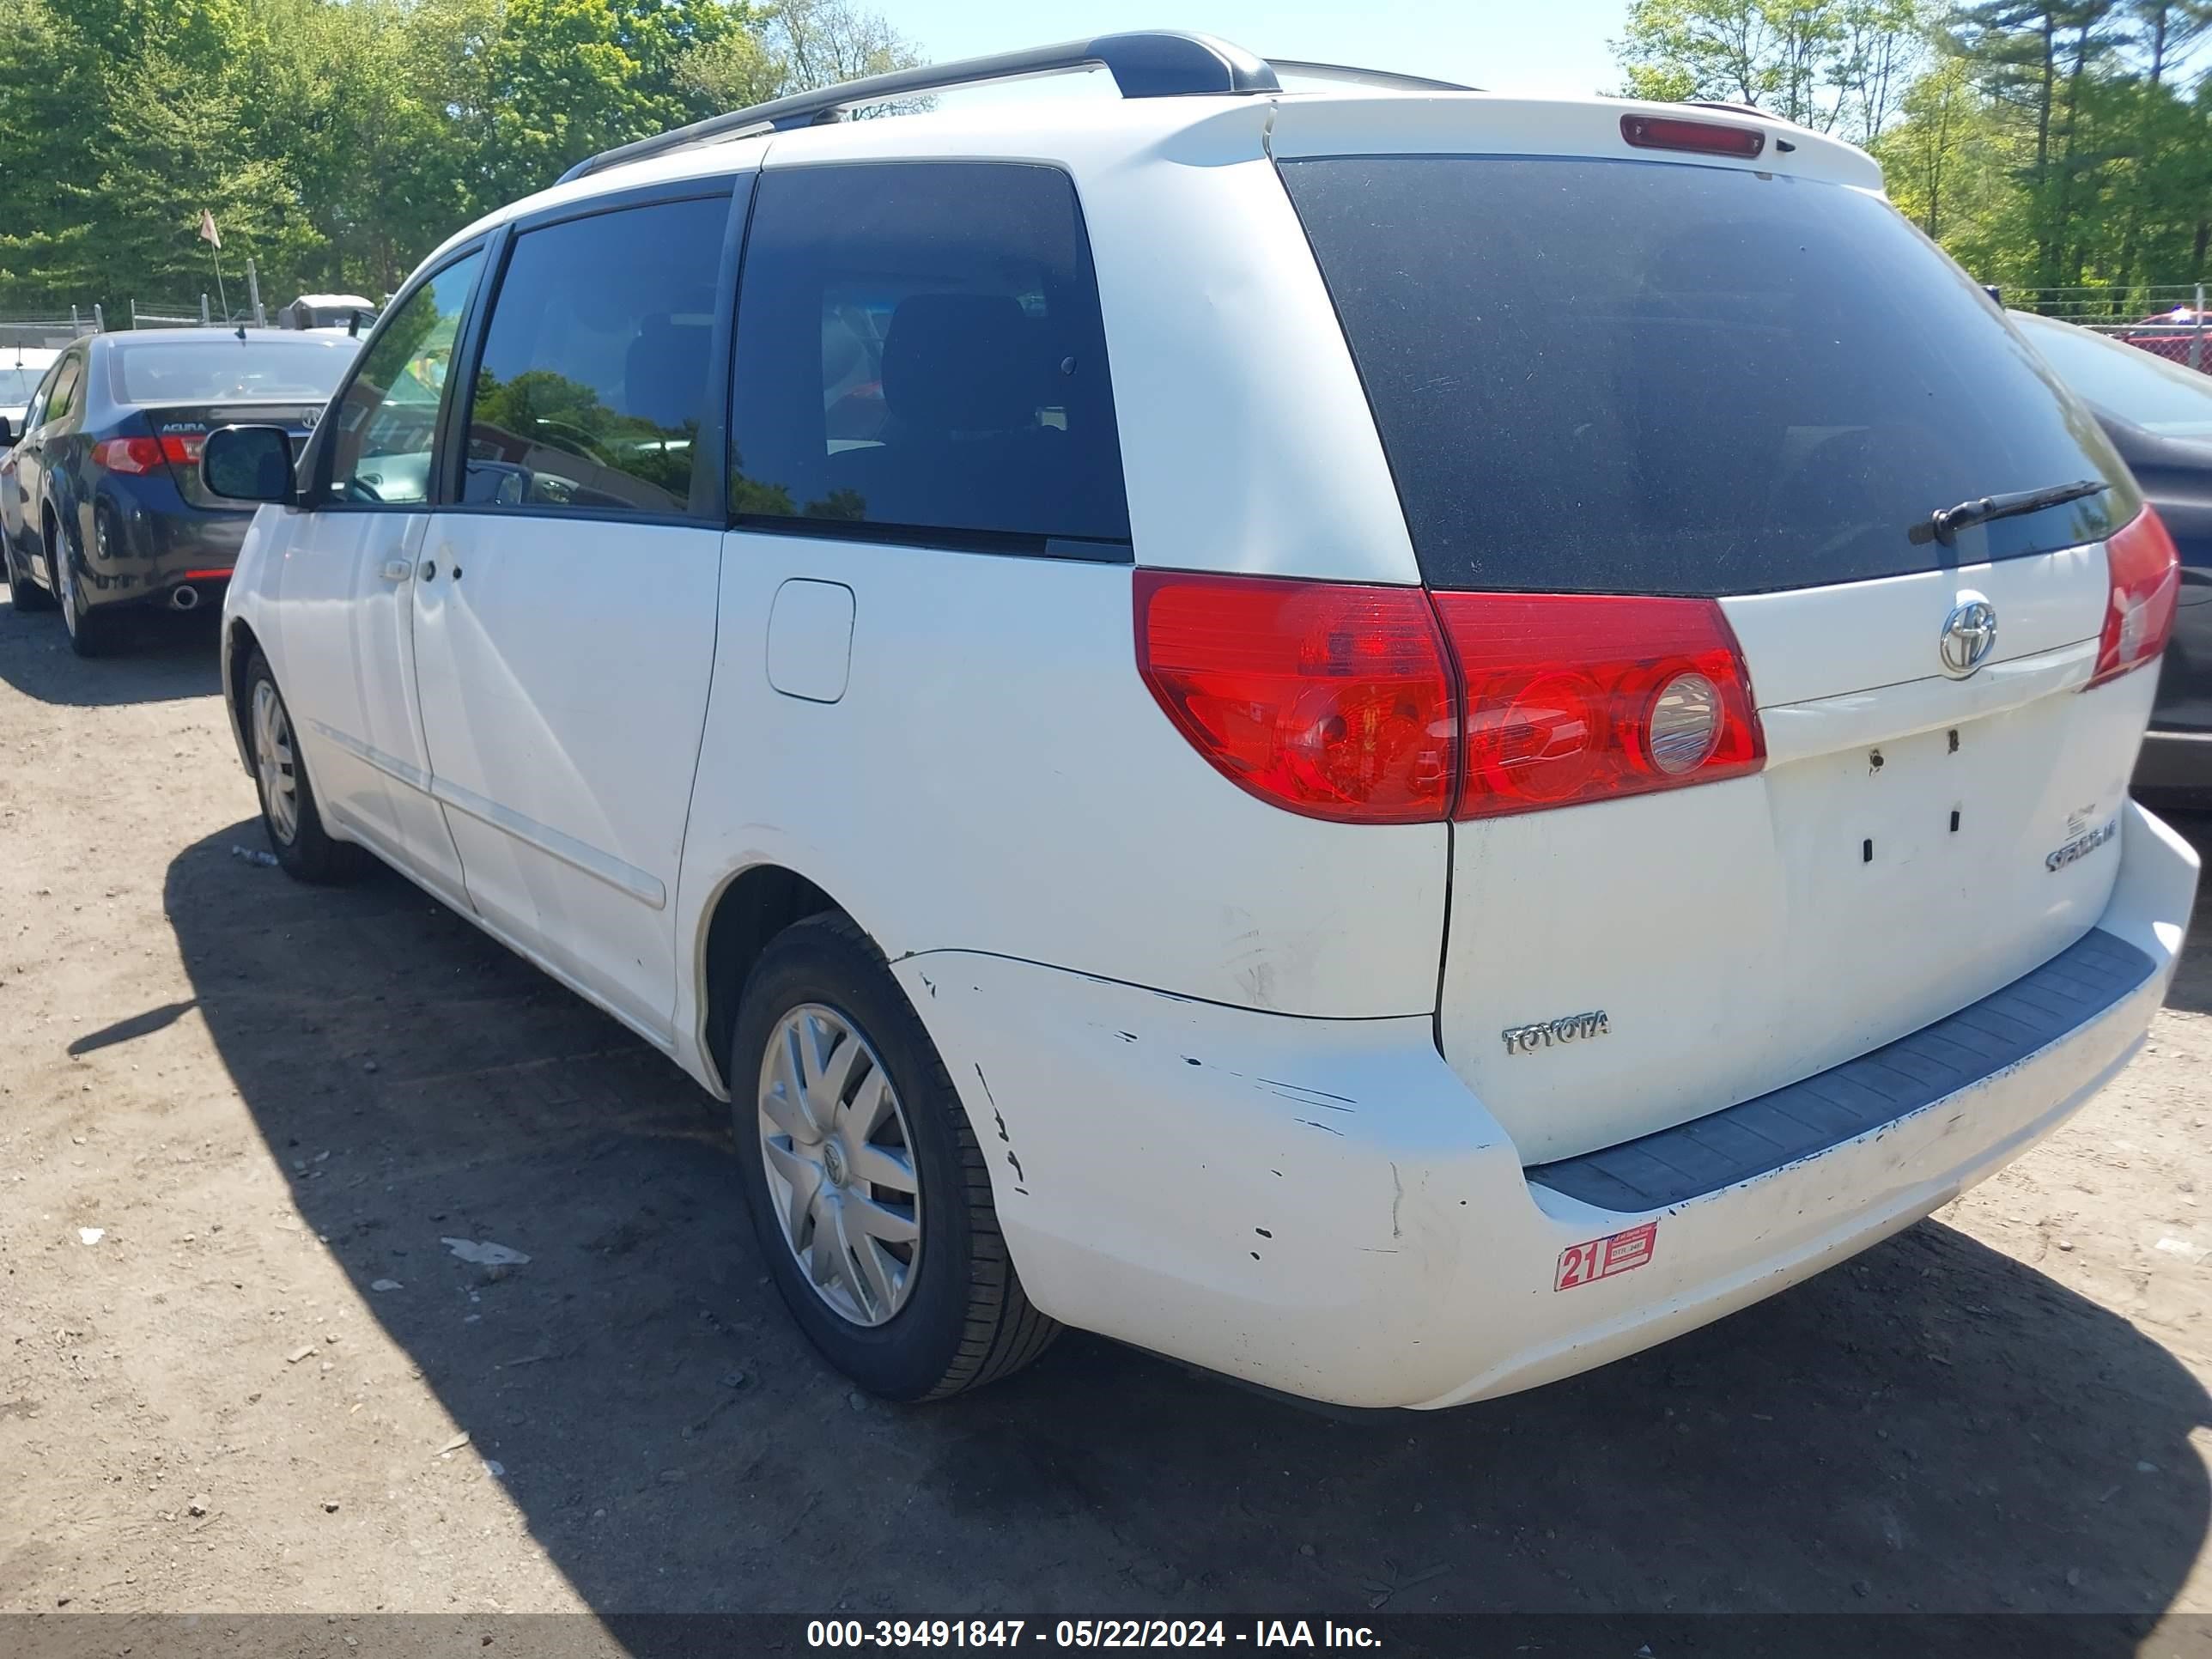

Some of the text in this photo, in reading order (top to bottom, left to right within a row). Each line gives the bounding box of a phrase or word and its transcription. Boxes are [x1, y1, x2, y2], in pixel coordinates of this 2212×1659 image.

[162, 422, 206, 433] ACURA
[1502, 1010, 1612, 1055] TOYOTA
[1560, 1243, 1598, 1287] 21
